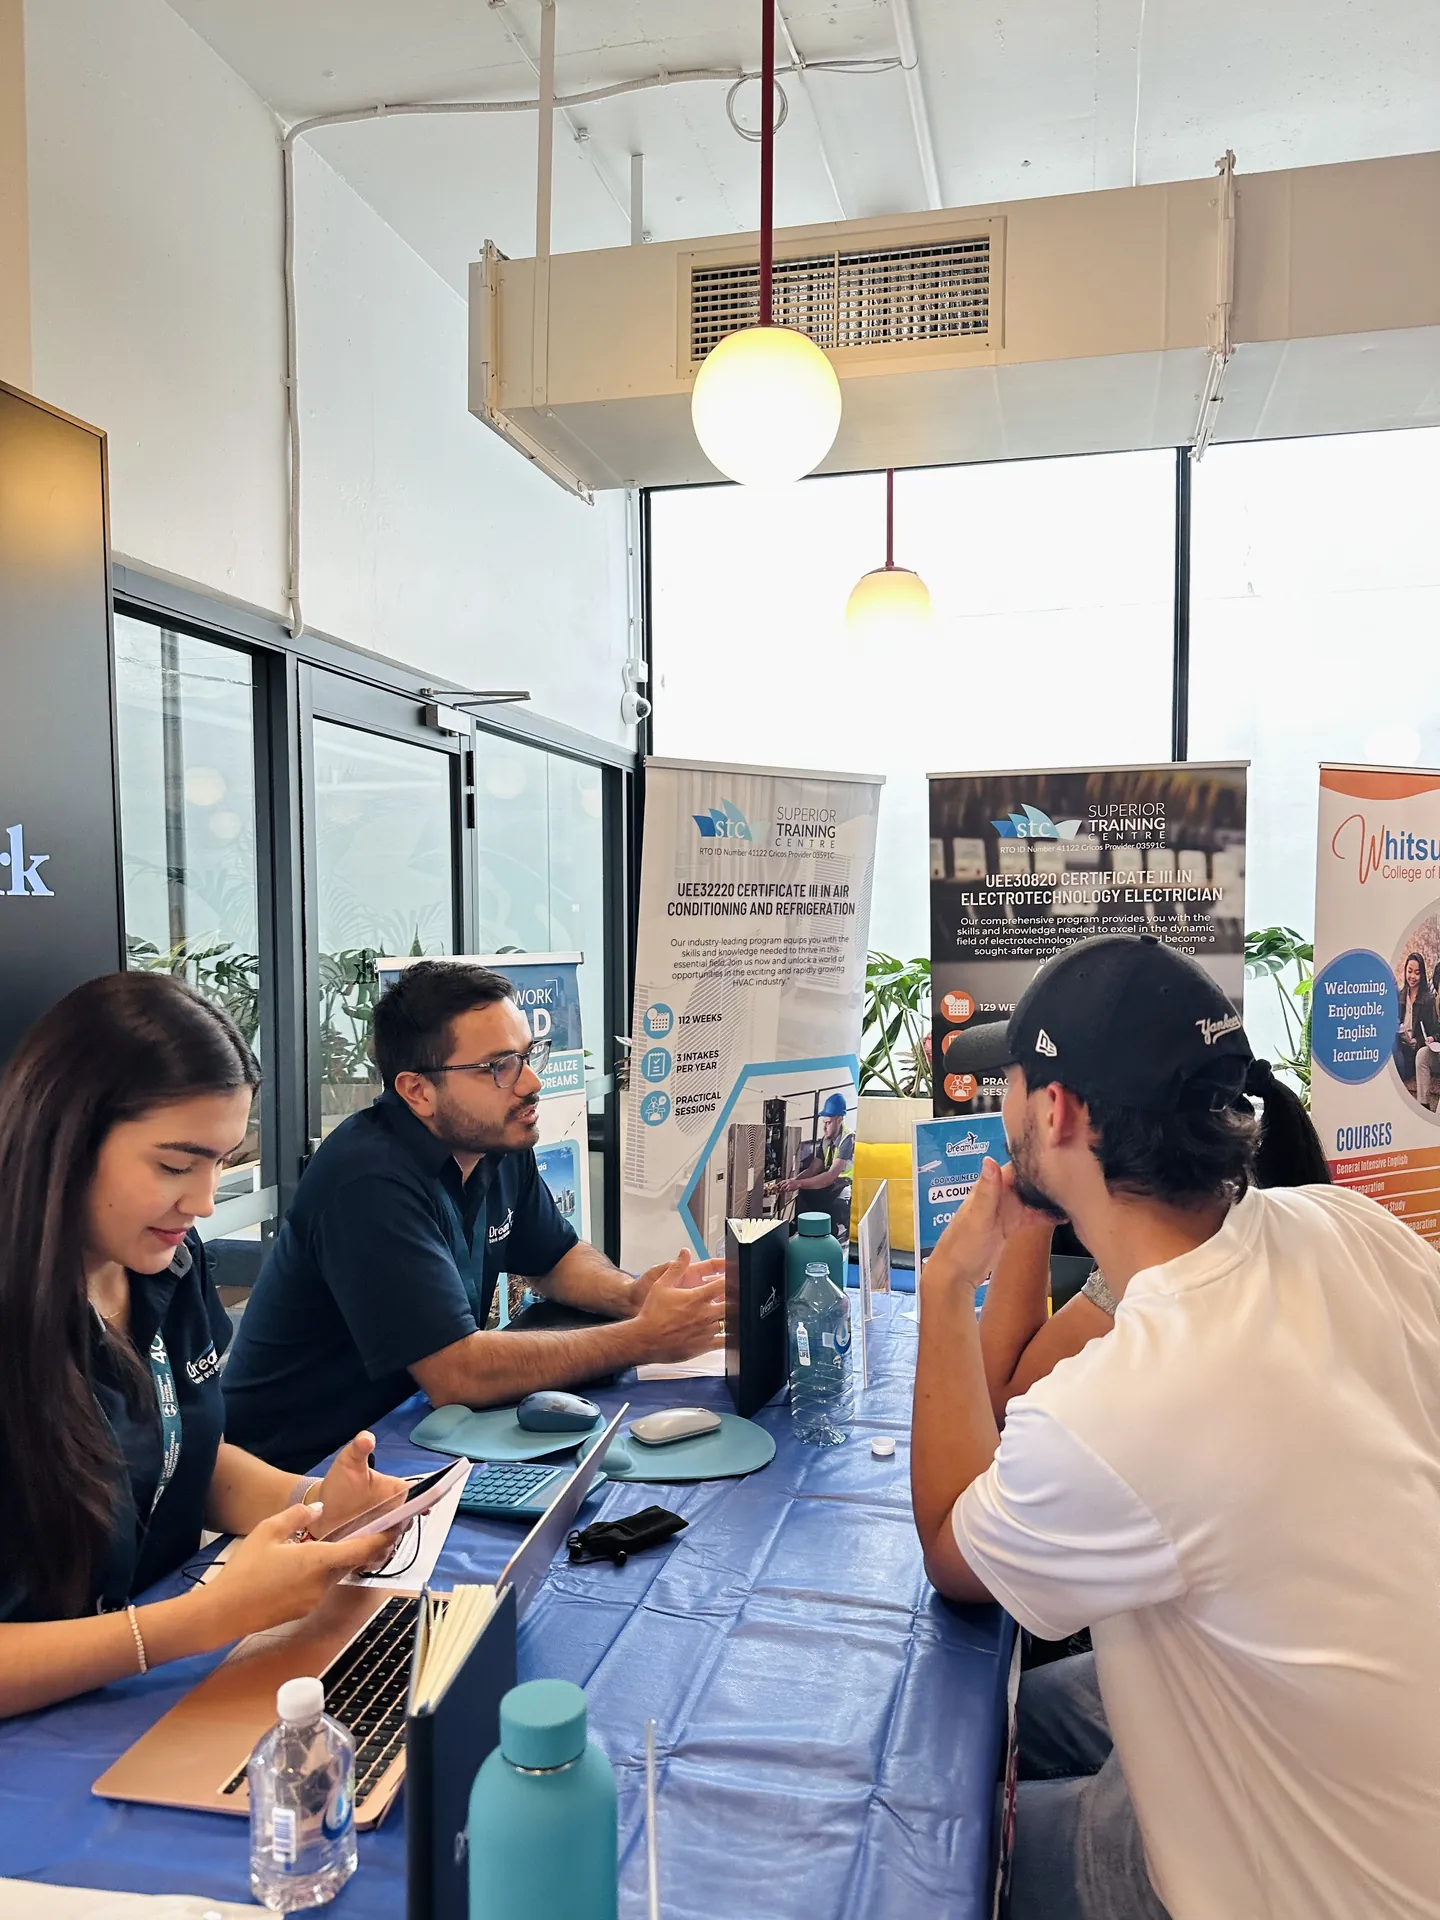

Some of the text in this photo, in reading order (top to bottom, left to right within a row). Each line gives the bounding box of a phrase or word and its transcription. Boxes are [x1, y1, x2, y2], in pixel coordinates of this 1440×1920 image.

[777, 806, 836, 822] SUPERIOR
[1088, 802, 1166, 818] SUPERIOR
[715, 818, 746, 839] stc
[777, 823, 836, 838] TRAINING
[1016, 818, 1051, 838] stc
[1089, 818, 1166, 832] TRAINING
[1088, 831, 1165, 841] CENTRE
[775, 838, 835, 848] CENTRE
[1000, 846, 1016, 854] RTO
[1028, 844, 1056, 853] Number
[1056, 844, 1080, 852] 41122
[1081, 843, 1104, 852] Cricos
[1105, 842, 1136, 850] Provider
[1136, 842, 1166, 850] 03591C
[700, 848, 714, 856] RTO
[714, 848, 722, 856] ID
[724, 848, 747, 856] Number
[768, 850, 787, 858] Cricos
[788, 850, 812, 858] Provider
[986, 870, 1192, 888] UEE30820 CERTIFICATE III IN
[1382, 864, 1436, 882] College of
[678, 882, 850, 898] UEE32220 CERTIFICATE III IN AIR
[960, 888, 1223, 906] ELECTROTECHNOLOGY ELECTRICIAN
[667, 902, 856, 916] CONDITIONING AND REFRIGERATION
[960, 914, 1210, 926] Our comprehensive program provides you with the
[957, 927, 980, 936] skills
[1002, 926, 1056, 936] knowledge
[1058, 926, 1096, 934] needed
[1110, 925, 1136, 933] excel
[1138, 924, 1148, 932] in
[1150, 924, 1168, 932] the
[1170, 924, 1214, 934] dynamic
[670, 938, 686, 947] Our
[688, 938, 748, 948] industry-leading
[749, 938, 782, 948] program
[783, 937, 808, 946] equips
[808, 938, 821, 946] you
[822, 936, 837, 944] with
[956, 937, 976, 946] field
[978, 937, 988, 945] of
[1166, 935, 1206, 943] become
[682, 949, 700, 958] skills
[702, 948, 716, 956] and
[718, 948, 758, 958] knowledge
[760, 947, 787, 955] needed
[798, 946, 818, 954] thrive
[819, 946, 826, 954] in
[827, 946, 840, 954] this
[974, 947, 1034, 956] sought-after
[674, 960, 708, 969] essential
[727, 958, 742, 967] Join
[754, 958, 770, 966] now
[772, 957, 786, 965] and
[788, 956, 811, 964] unlock
[818, 956, 837, 964] world
[672, 970, 722, 980] opportunities
[732, 969, 744, 977] the
[746, 968, 776, 978] exciting
[778, 967, 791, 976] and
[792, 966, 816, 976] rapidly
[818, 966, 844, 975] growing
[733, 978, 754, 986] HVAC
[1324, 980, 1388, 996] Welcoming,
[980, 1004, 996, 1012] 129
[1328, 1002, 1384, 1020] Enjoyable,
[678, 1014, 722, 1024] 112 WEEKS
[1337, 1024, 1376, 1042] English
[684, 1050, 719, 1061] INTAKES
[1333, 1047, 1379, 1062] learning
[542, 1060, 578, 1074] REALIZE
[676, 1062, 717, 1073] PER YEAR
[541, 1074, 578, 1089] DREAMS
[676, 1092, 721, 1105] PRACTICAL
[675, 1104, 716, 1116] SESSIONS
[1336, 1122, 1392, 1152] COURSES
[1336, 1155, 1408, 1174] General Intensive English
[1390, 1200, 1406, 1212] Study
